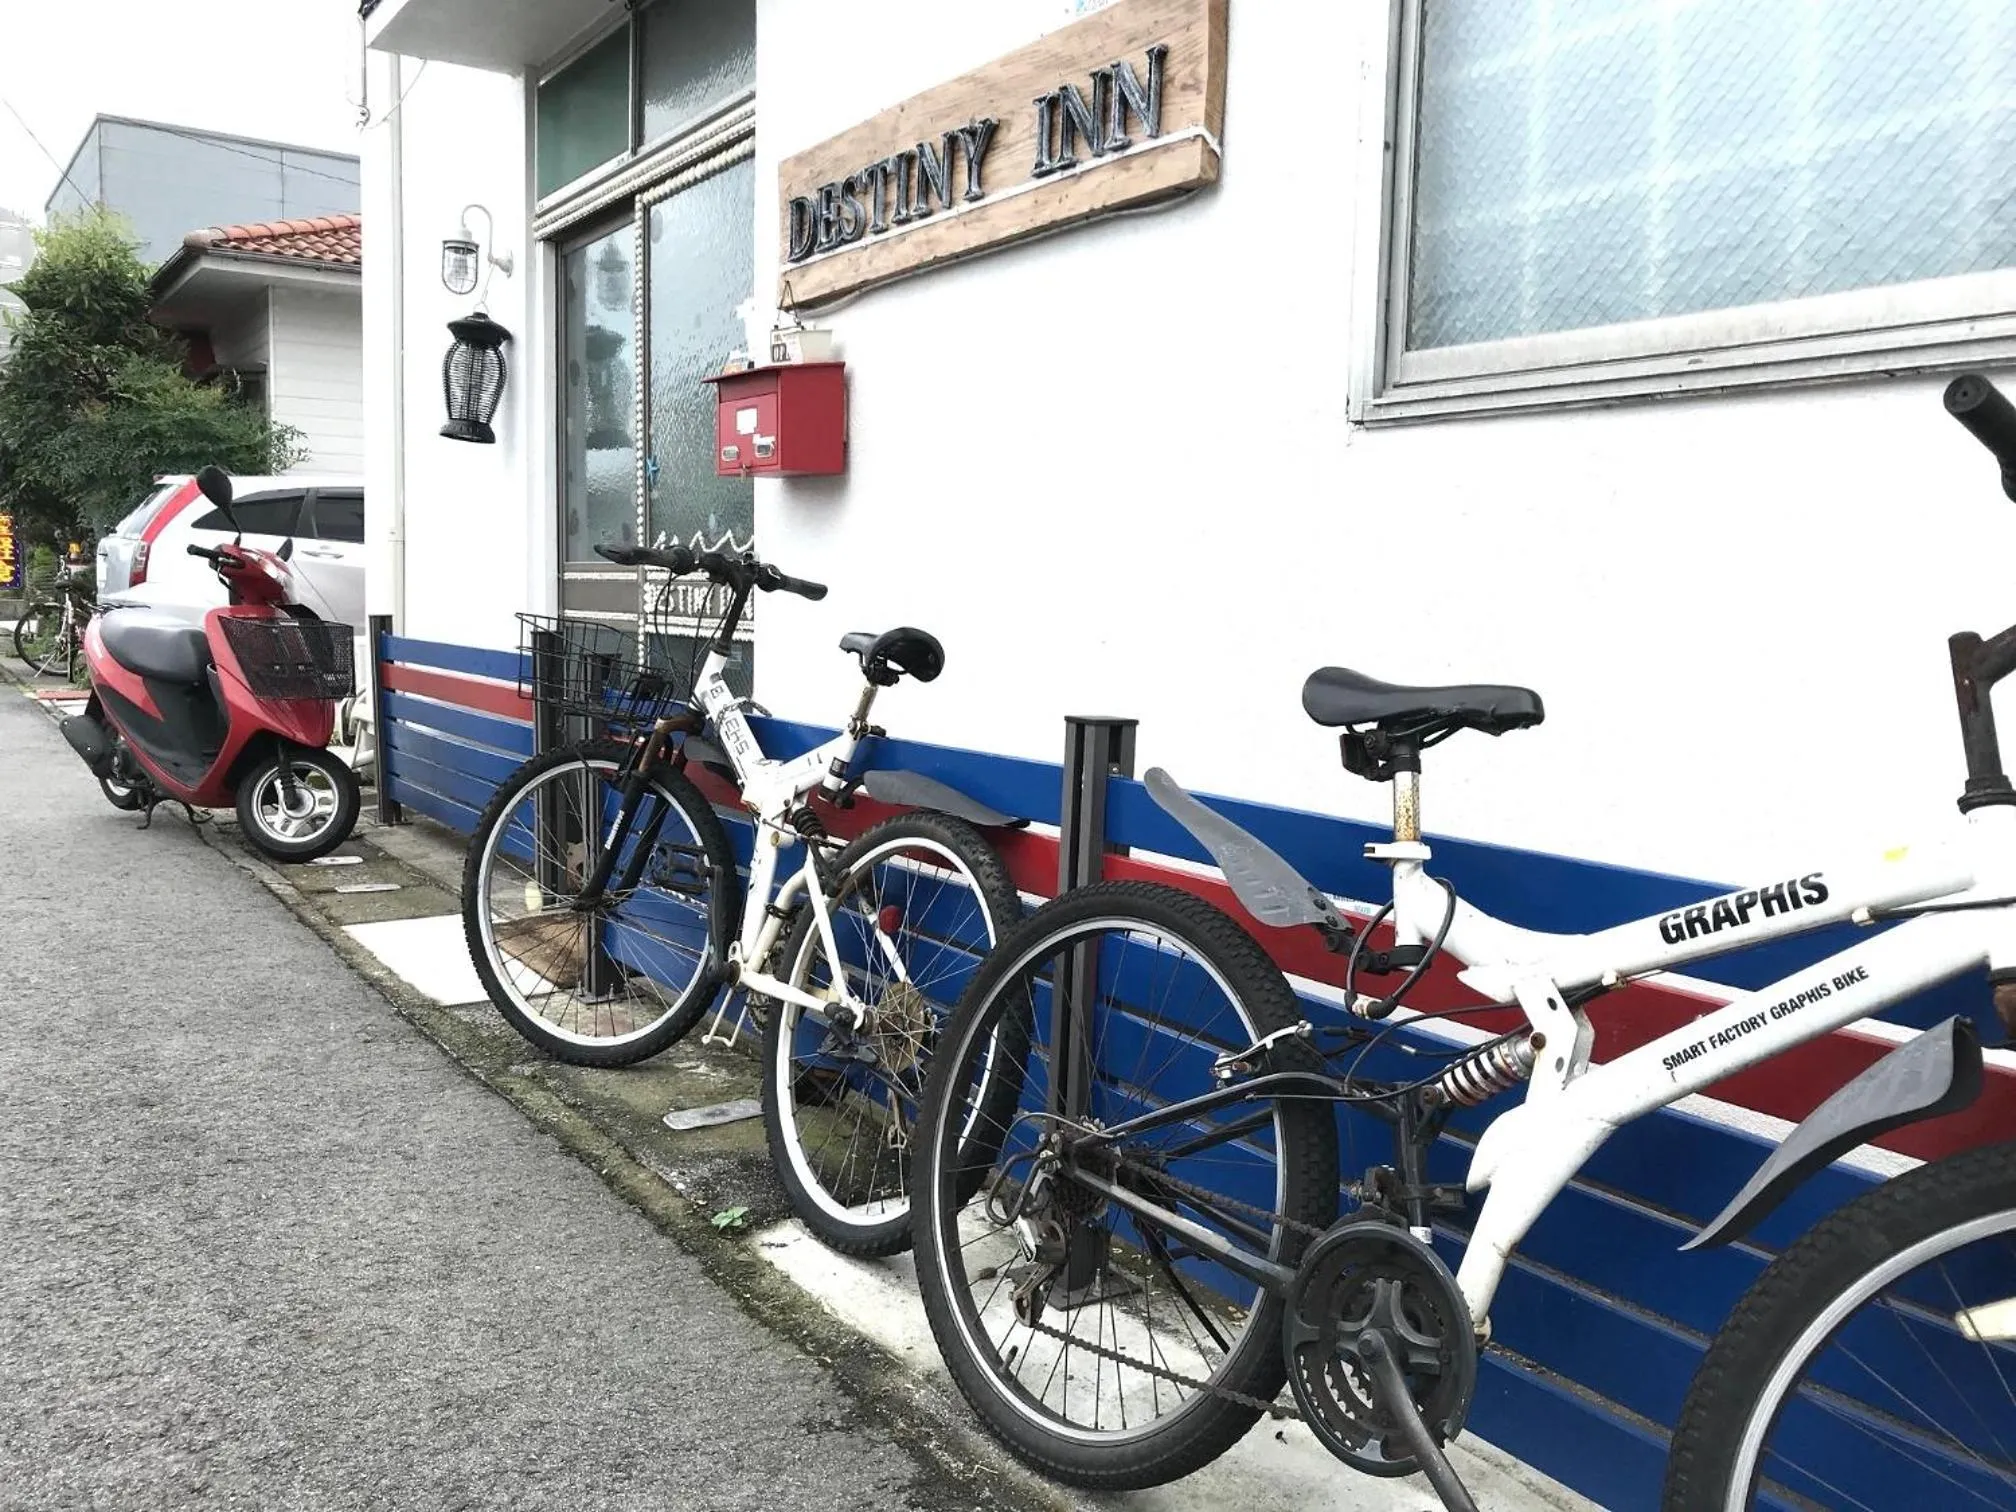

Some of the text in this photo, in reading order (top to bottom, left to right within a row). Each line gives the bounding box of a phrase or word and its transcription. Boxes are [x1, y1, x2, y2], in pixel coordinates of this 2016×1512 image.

[788, 43, 1169, 262] DESTINY INN
[1659, 872, 1829, 945] GRAPHIS
[1662, 965, 1870, 1071] SMART FACTORY GRAPHIS BIKE
